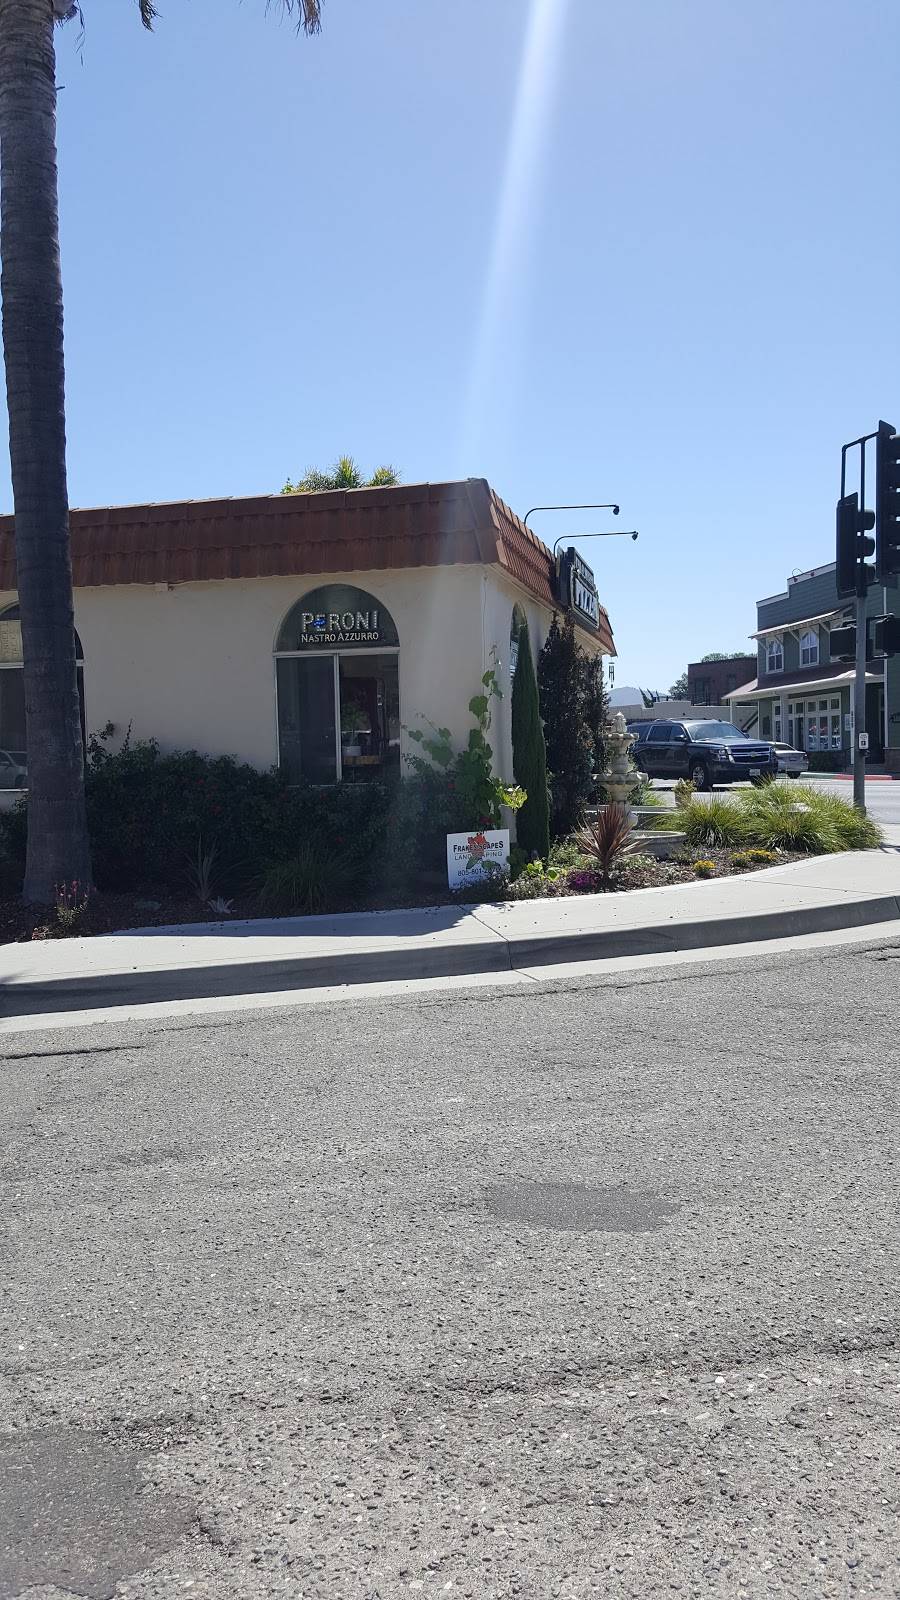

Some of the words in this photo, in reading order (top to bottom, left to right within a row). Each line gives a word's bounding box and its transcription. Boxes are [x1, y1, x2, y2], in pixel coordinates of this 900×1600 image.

[301, 611, 378, 632] PERONI
[301, 633, 336, 643] NASTRO
[337, 632, 379, 641] AZZURRO
